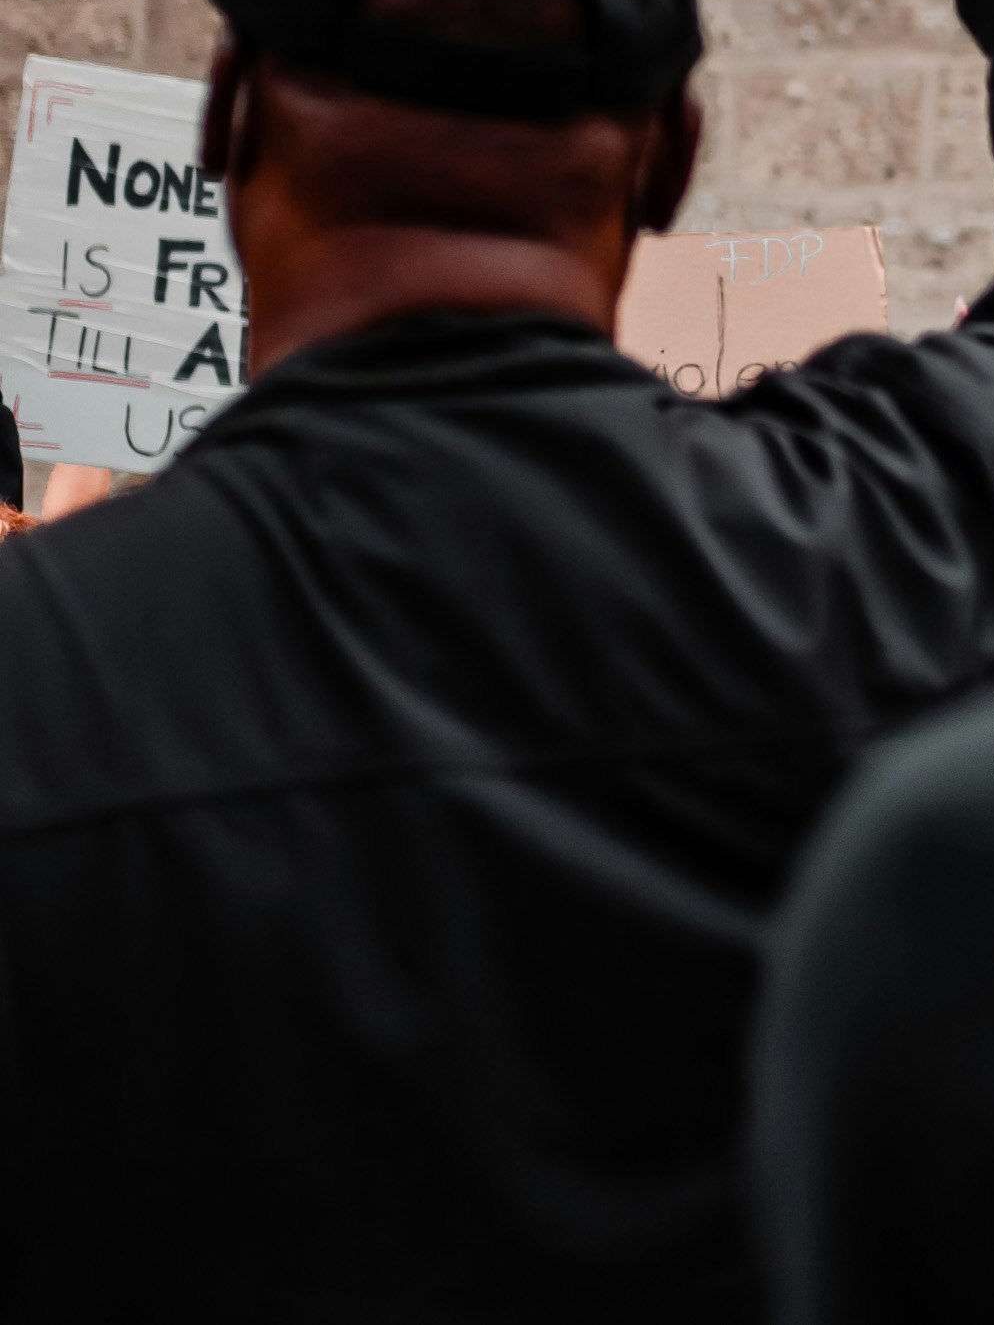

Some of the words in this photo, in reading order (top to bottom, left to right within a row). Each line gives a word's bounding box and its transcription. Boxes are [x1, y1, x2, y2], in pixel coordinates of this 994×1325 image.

[66, 137, 219, 217] NONE
[61, 240, 112, 298] IS
[154, 237, 248, 318] FR
[706, 233, 824, 286] FDP
[28, 307, 150, 378] TILL
